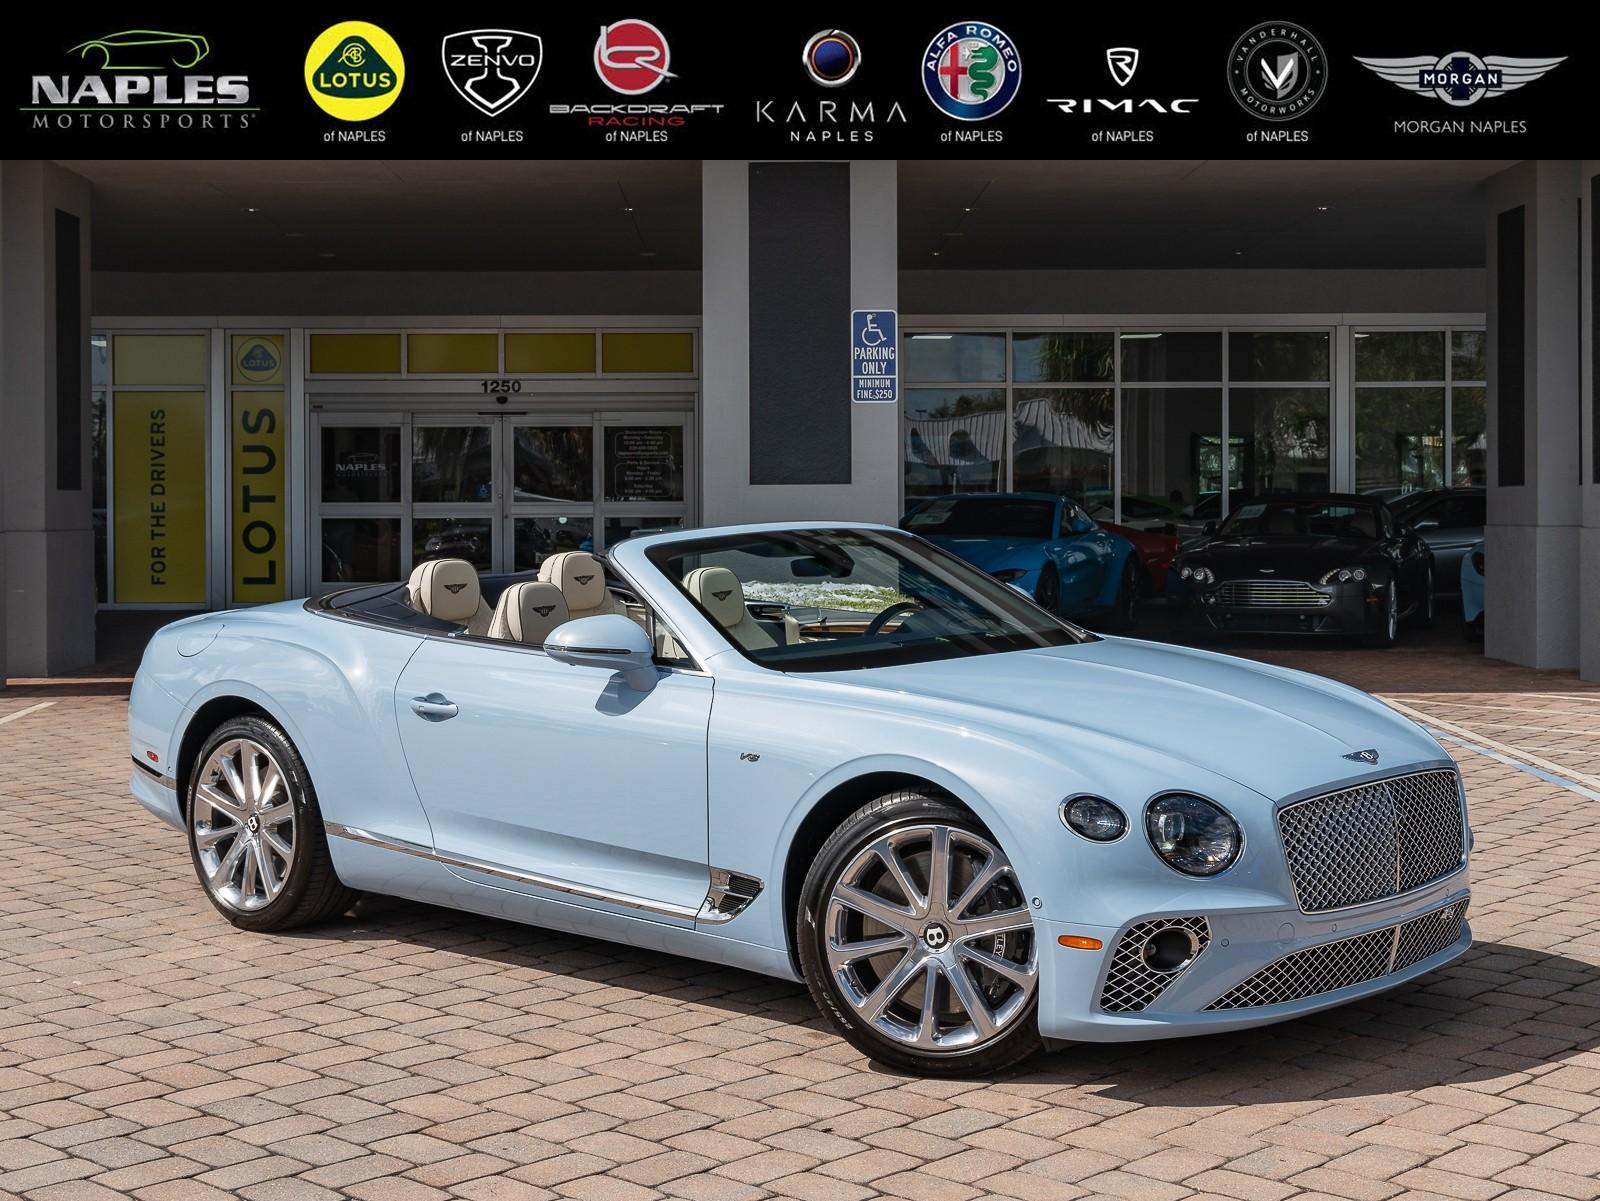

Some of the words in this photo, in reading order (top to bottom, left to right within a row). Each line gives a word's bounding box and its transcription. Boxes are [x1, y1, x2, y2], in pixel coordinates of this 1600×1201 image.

[854, 347, 895, 360] PARKING
[242, 359, 275, 369] LOTUS
[862, 361, 887, 375] ONLY
[481, 380, 521, 394] 1250
[859, 379, 891, 388] MINIMUM
[856, 389, 873, 399] FINE
[875, 389, 893, 399] $250
[151, 408, 166, 496] DRIVERS
[335, 463, 386, 472] NAPLES
[242, 408, 276, 585] LOTUS
[151, 501, 166, 541] THE
[151, 550, 166, 585] FOR
[995, 933, 1004, 957] TLEY
